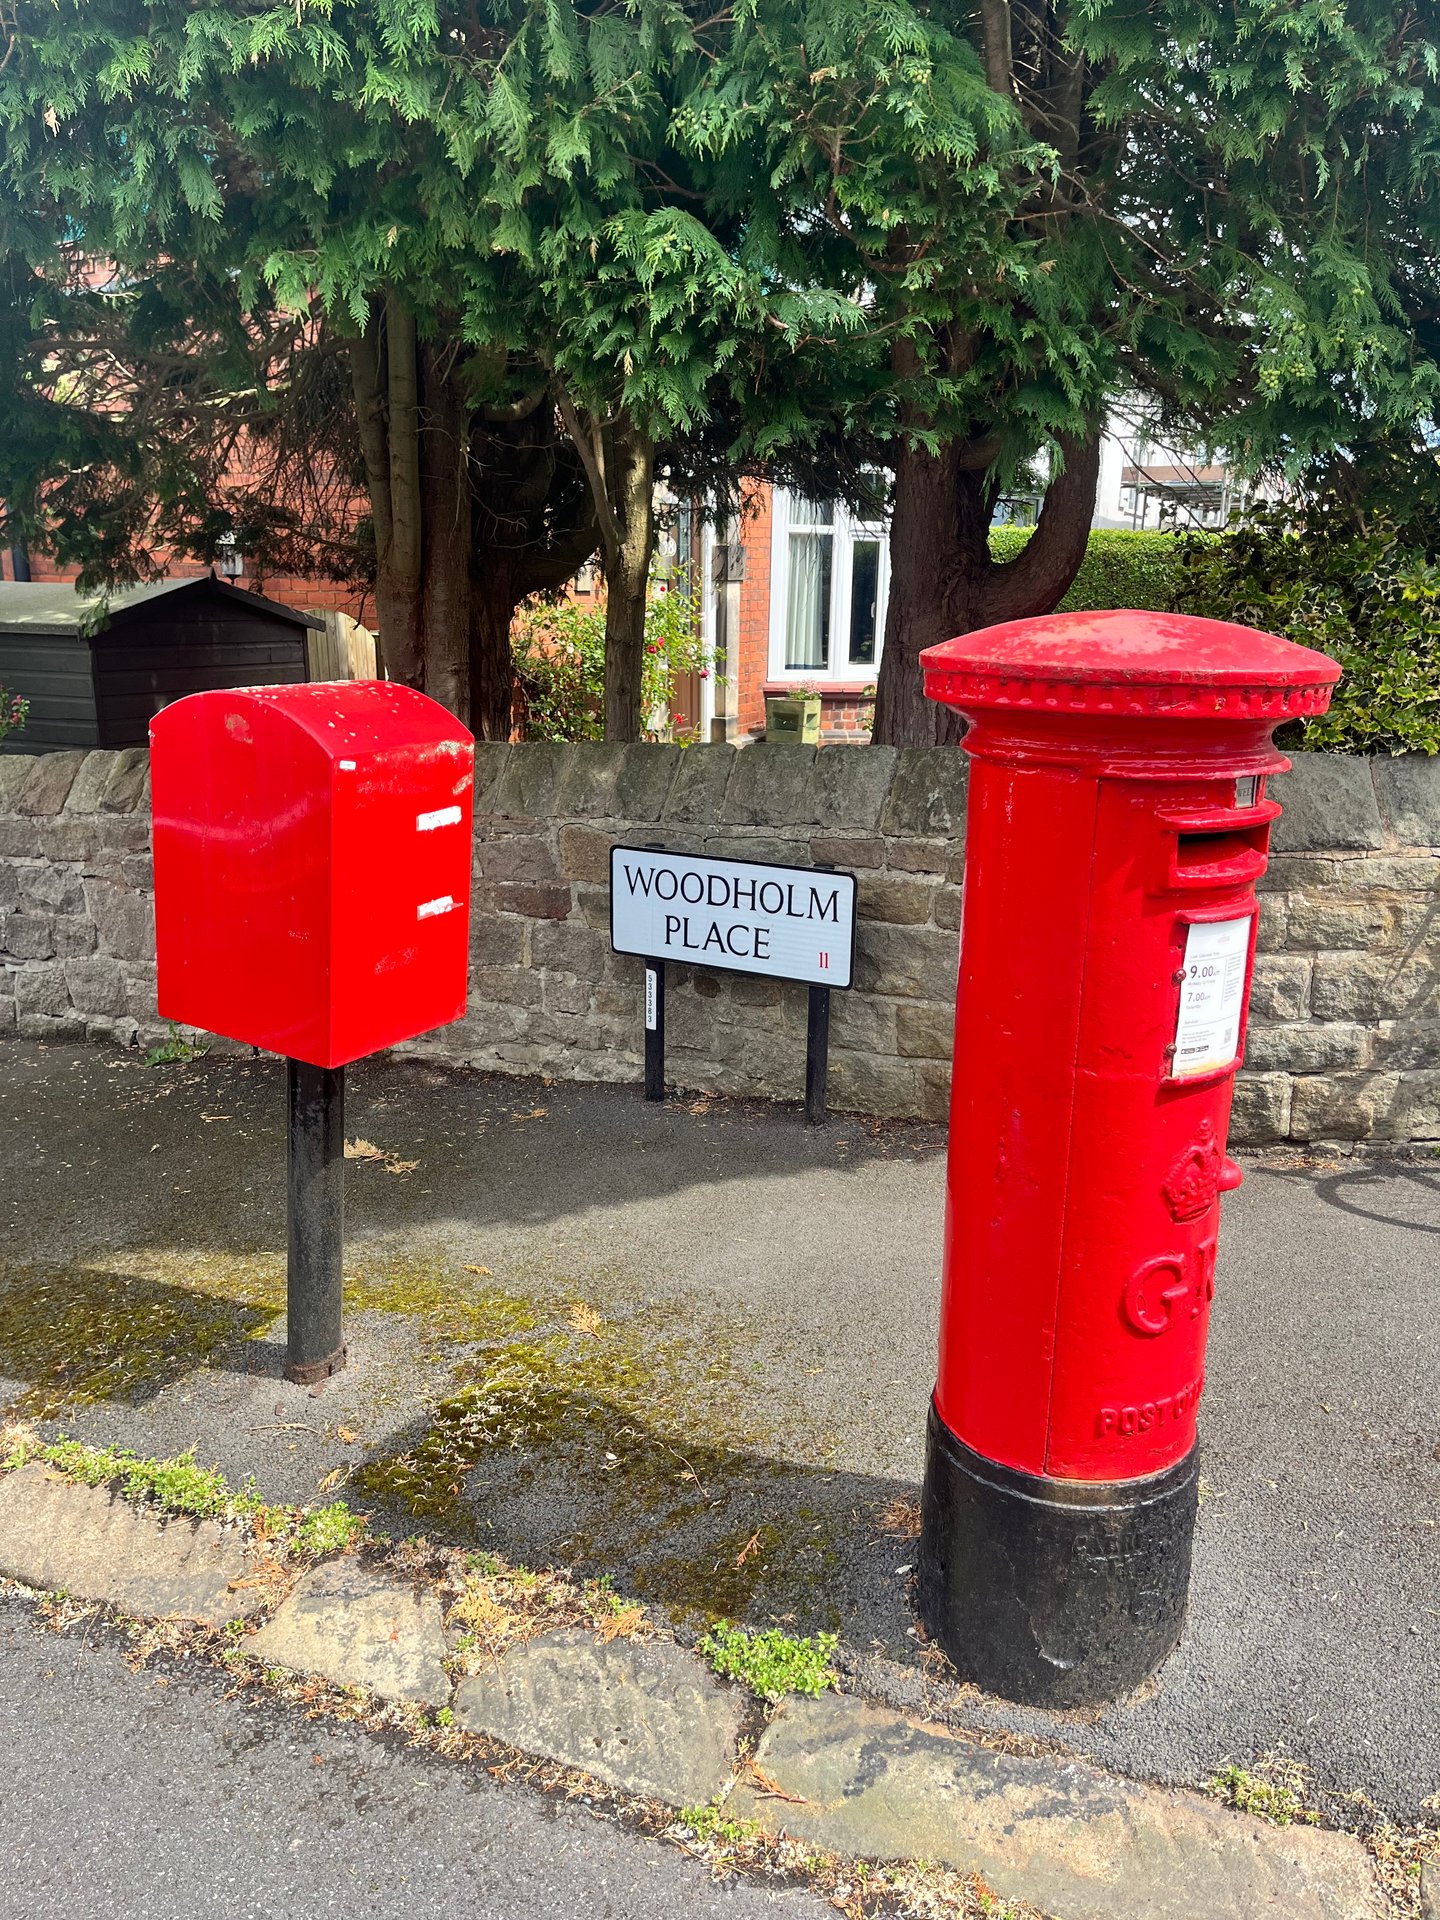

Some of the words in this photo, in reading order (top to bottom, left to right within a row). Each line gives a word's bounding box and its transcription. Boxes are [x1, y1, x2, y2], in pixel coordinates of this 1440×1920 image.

[623, 865, 840, 923] WOODHOLM
[664, 915, 771, 960] PLACE
[819, 952, 829, 969] 11
[1098, 1397, 1172, 1436] POST
